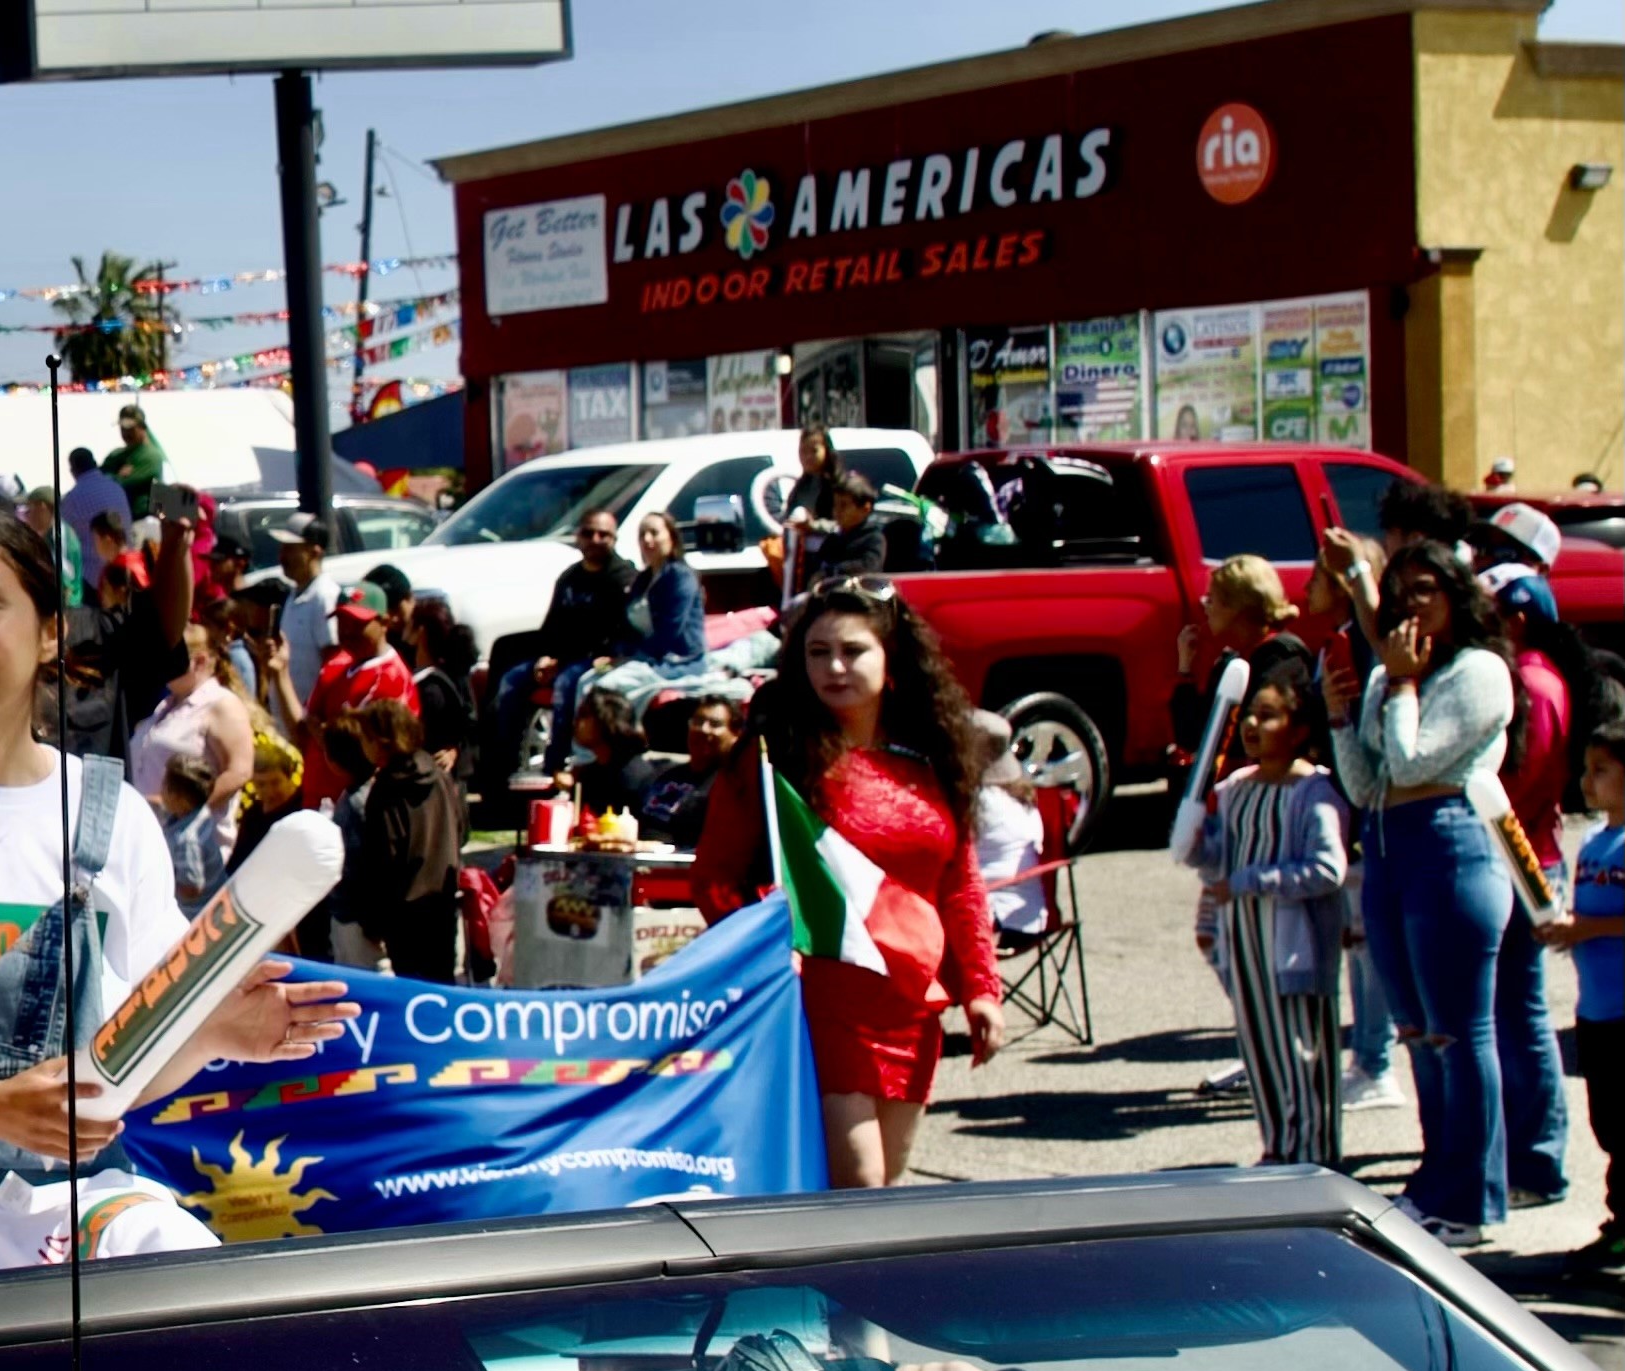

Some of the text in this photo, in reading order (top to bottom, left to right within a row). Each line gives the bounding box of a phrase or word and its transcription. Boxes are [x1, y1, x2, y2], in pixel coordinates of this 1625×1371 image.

[1204, 114, 1260, 170] ria
[614, 128, 1111, 264] LAS AMERICAS
[490, 206, 599, 253] Get Better
[640, 266, 771, 313] INDOOR
[784, 247, 903, 296] RETAIL
[920, 230, 1045, 278] SALES
[1063, 364, 1136, 382] Dinero
[579, 385, 628, 421] TAX
